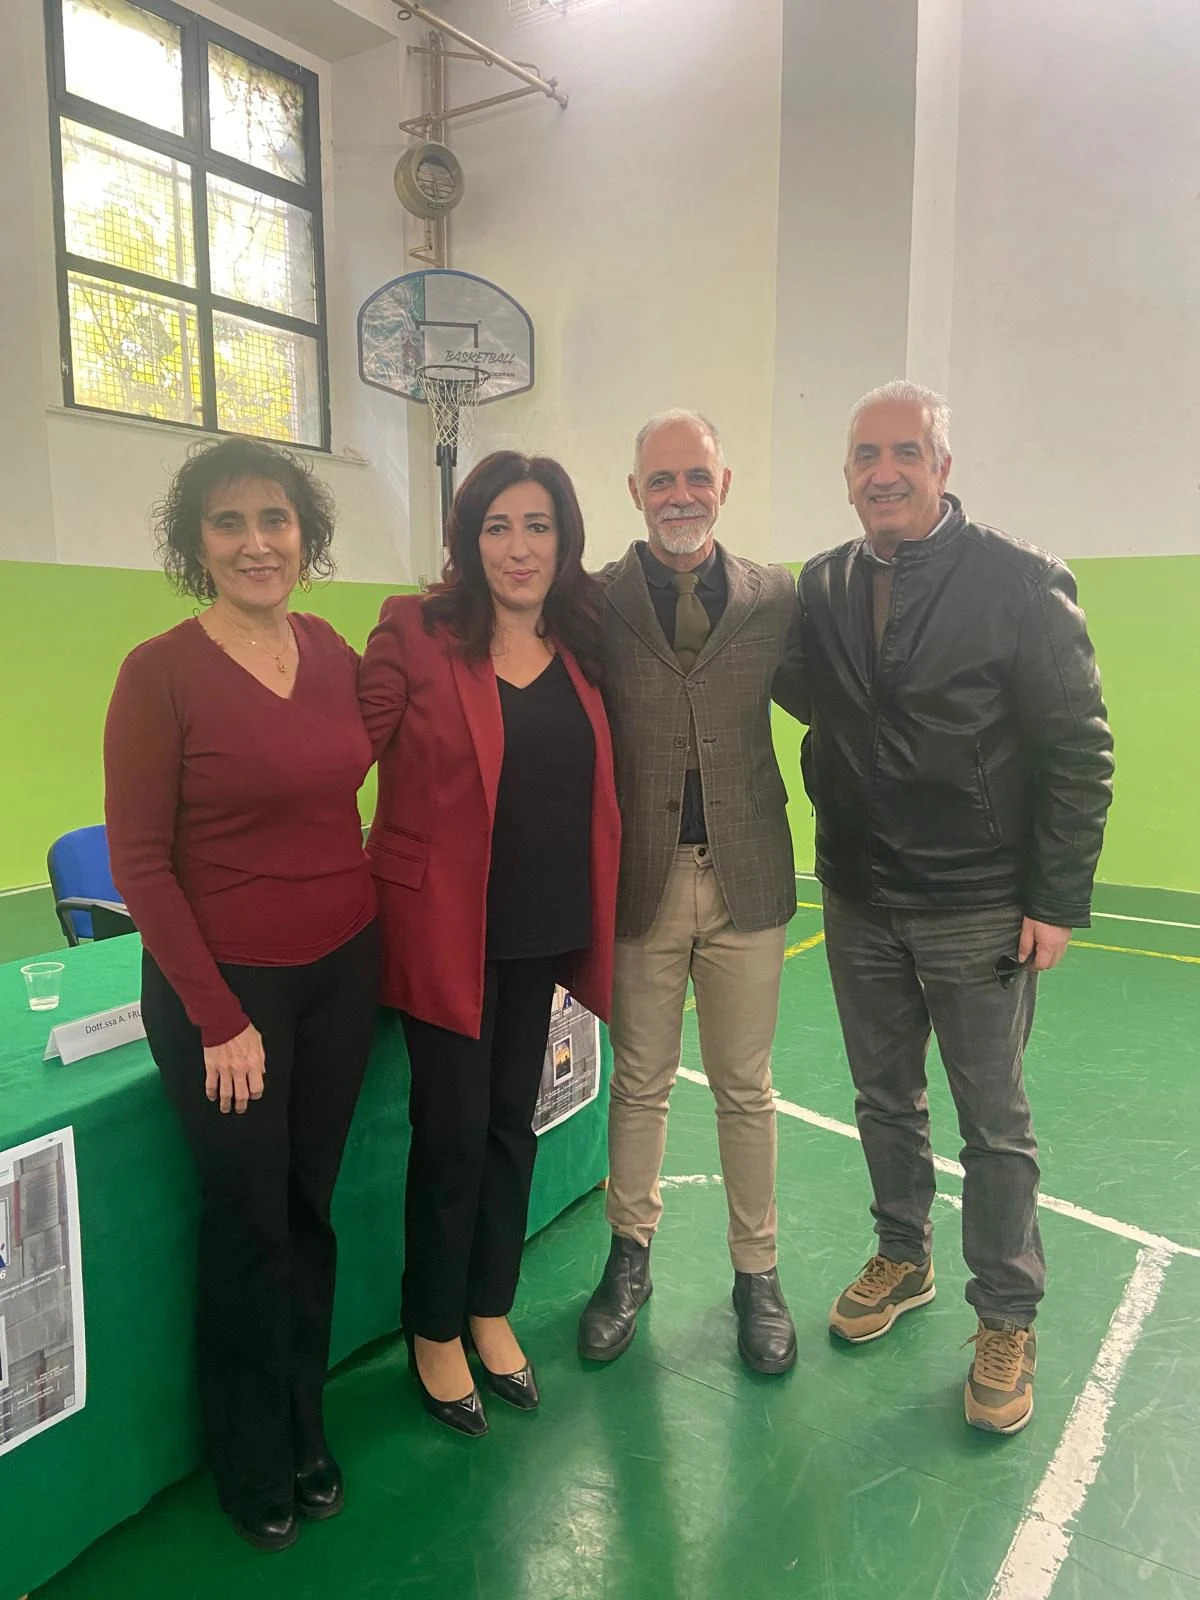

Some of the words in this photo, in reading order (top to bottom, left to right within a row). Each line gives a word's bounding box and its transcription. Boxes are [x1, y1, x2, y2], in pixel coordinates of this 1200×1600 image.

[445, 350, 515, 364] BASKETBALL
[85, 1019, 117, 1034] Dott.ssa
[119, 1015, 127, 1023] A.
